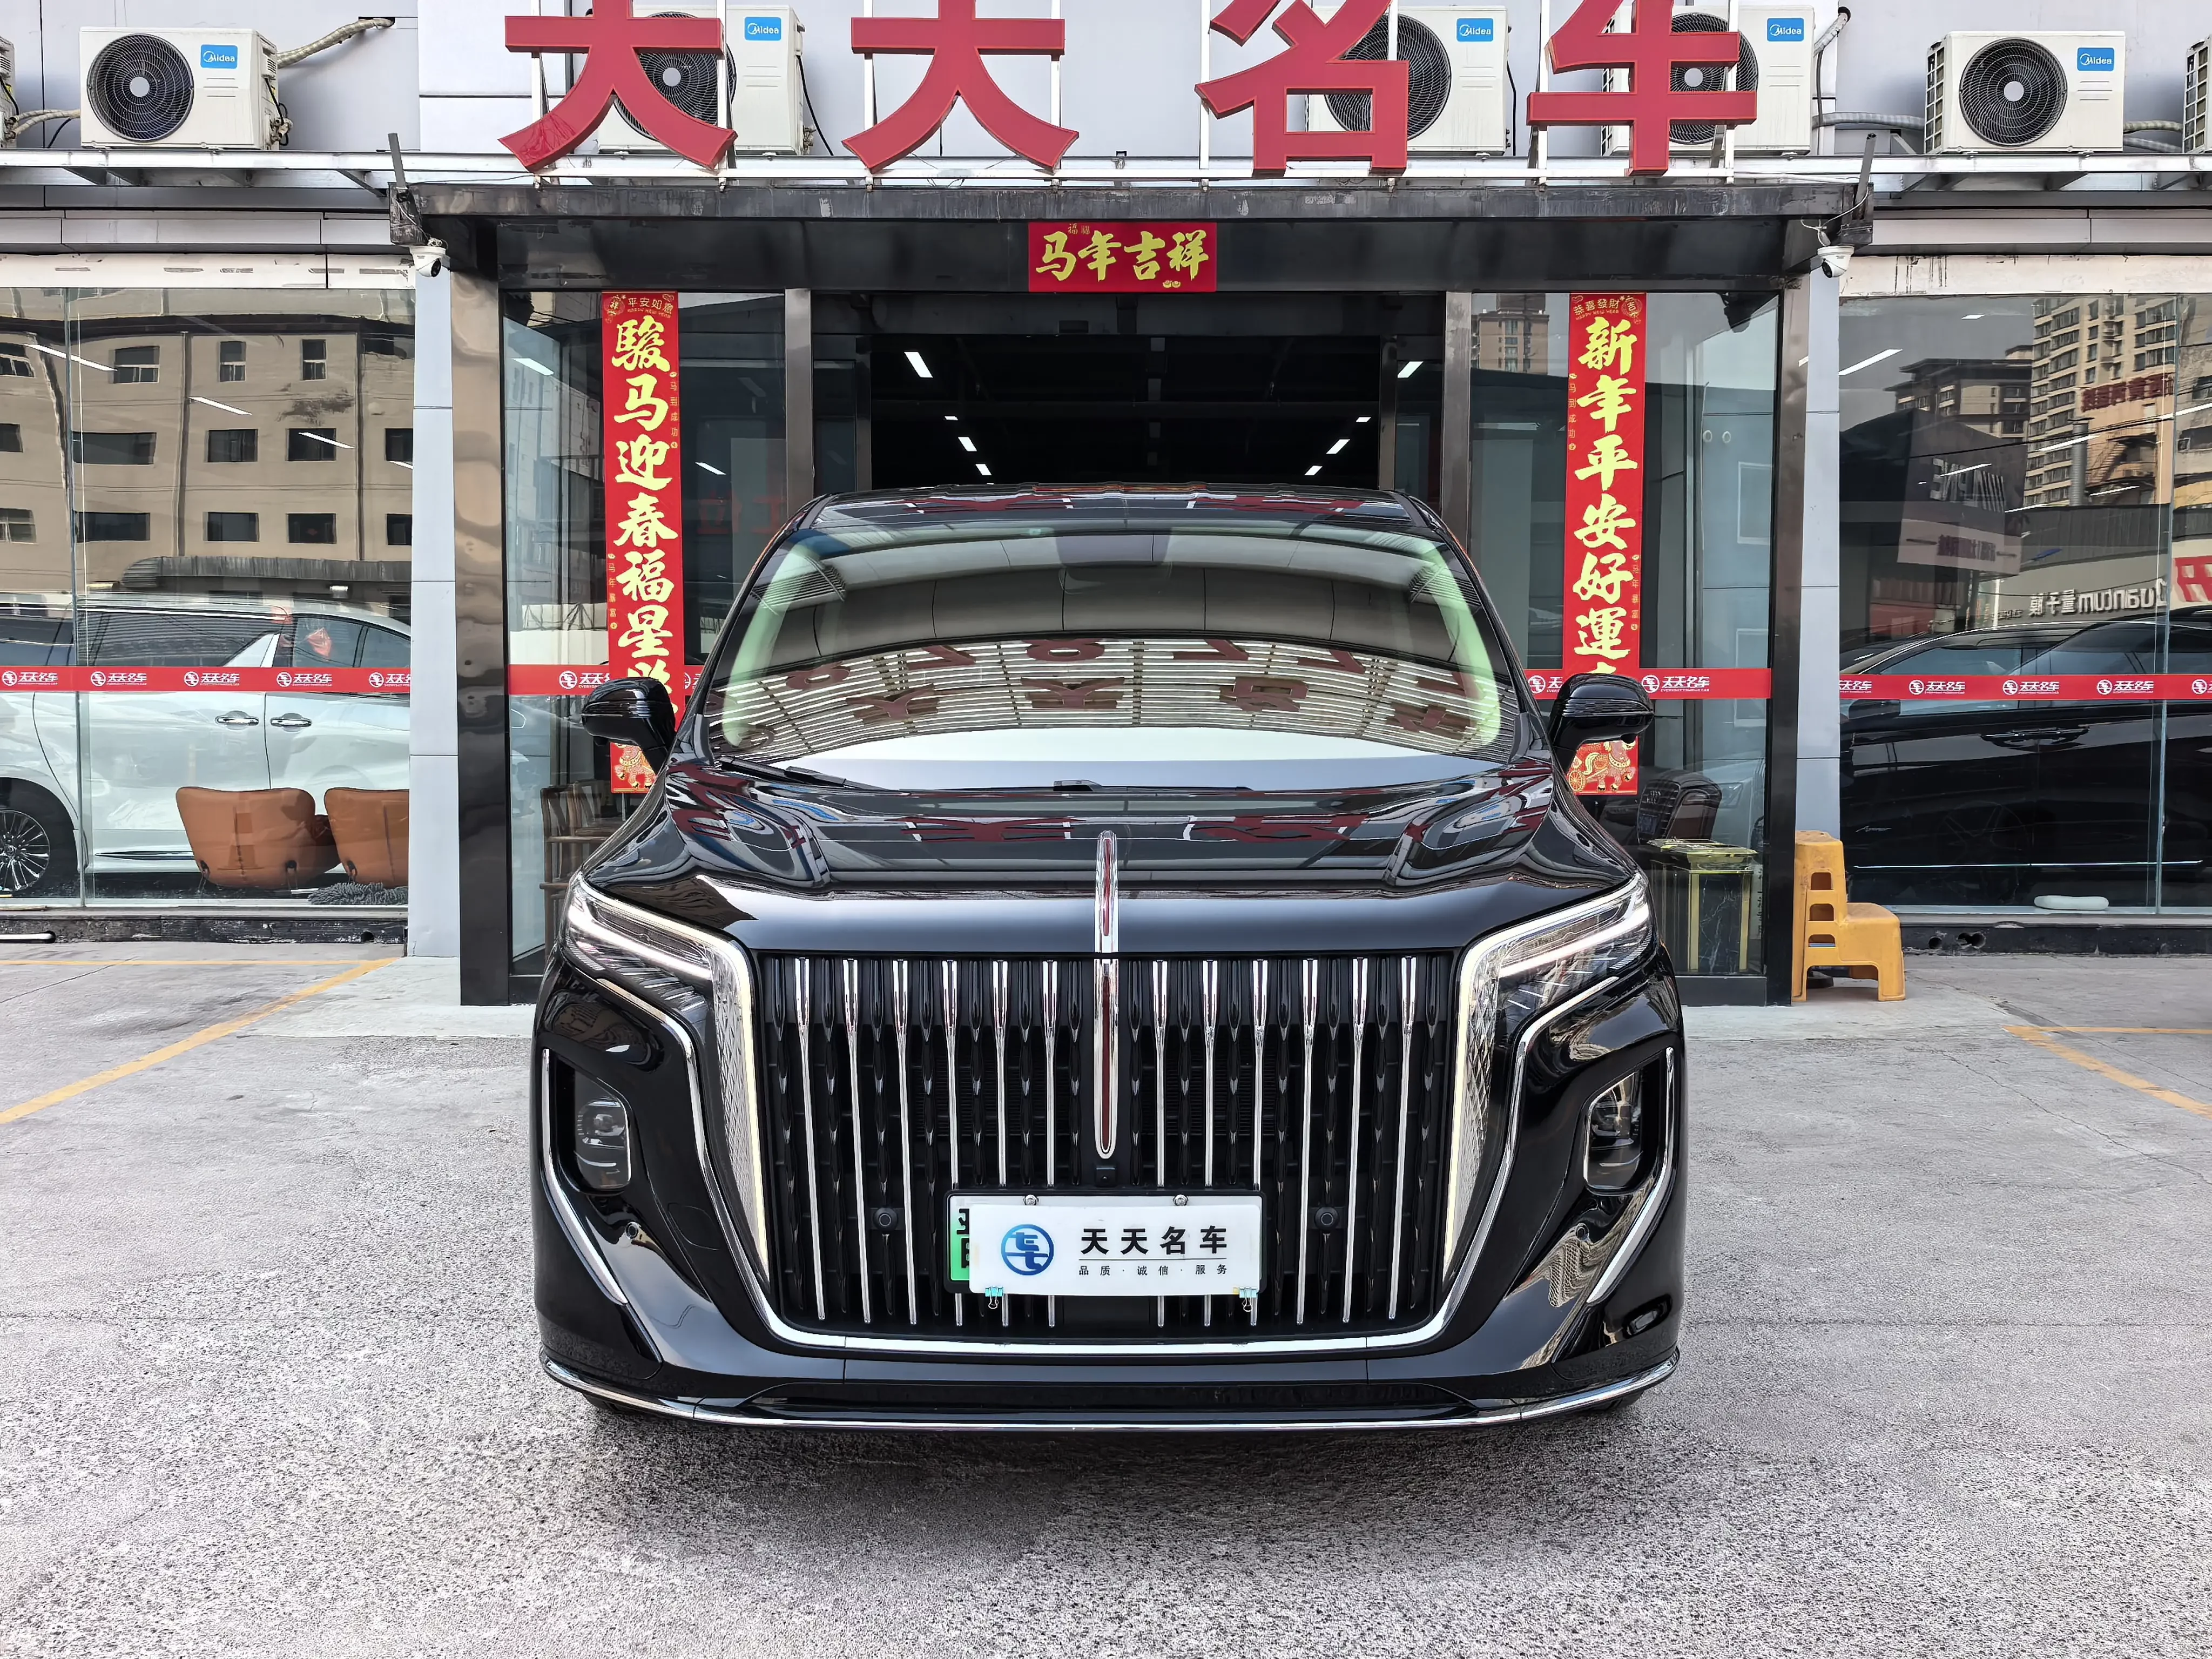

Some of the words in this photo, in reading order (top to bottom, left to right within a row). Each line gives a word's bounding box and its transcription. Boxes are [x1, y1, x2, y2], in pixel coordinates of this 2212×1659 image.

[747, 23, 779, 35] Midea
[1459, 24, 1491, 36] Midea
[1770, 24, 1802, 36] Midea
[203, 51, 235, 63] Midea
[2080, 53, 2112, 65] Midea
[1035, 230, 1209, 282] 马年吉祥
[1573, 316, 1638, 675] 新年平安好運
[18, 672, 59, 682] 天天名车
[107, 672, 147, 683] 天天名车
[200, 672, 240, 683] 天天名车
[293, 673, 332, 684] 天天名车
[579, 673, 610, 685] 天天
[1662, 676, 1710, 689] 天天名车
[1925, 681, 1965, 691] 天天名车
[2019, 681, 2060, 692] 天天名车
[2114, 680, 2154, 691] 天天名车
[1081, 1225, 1227, 1255] 天天名车
